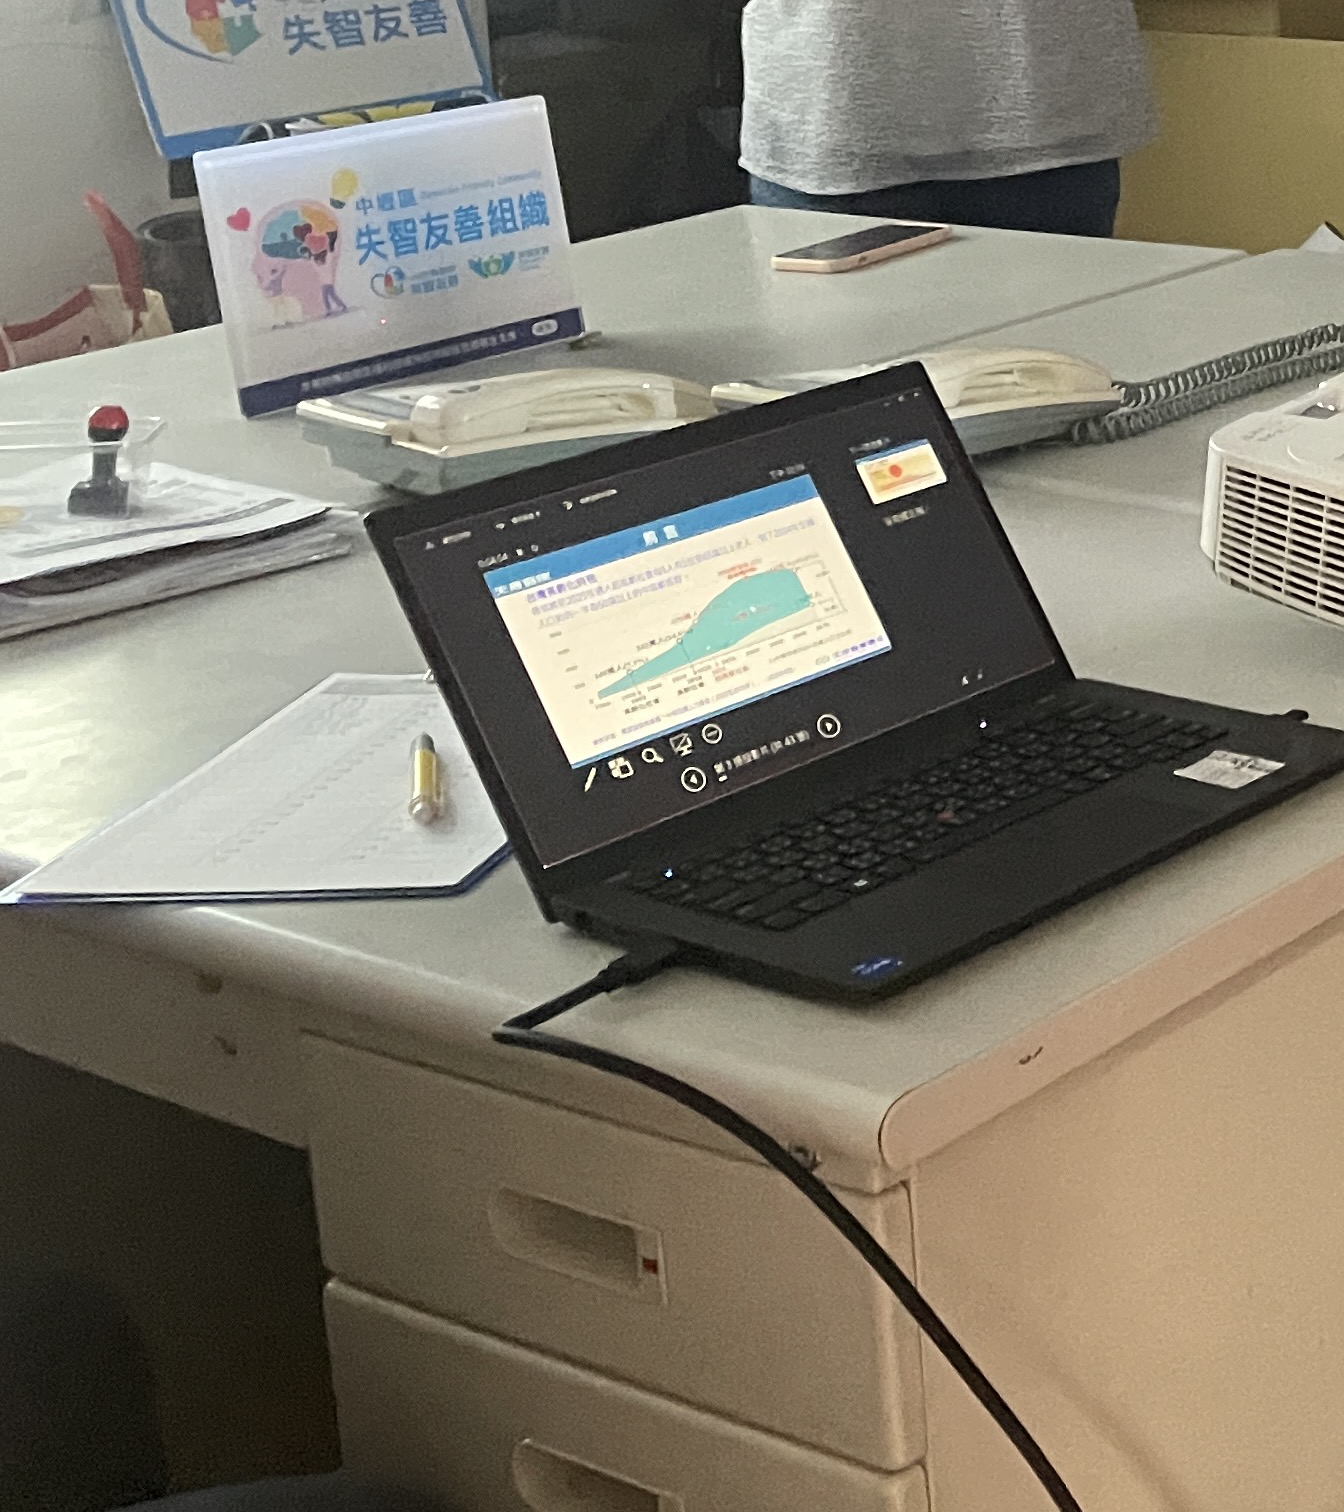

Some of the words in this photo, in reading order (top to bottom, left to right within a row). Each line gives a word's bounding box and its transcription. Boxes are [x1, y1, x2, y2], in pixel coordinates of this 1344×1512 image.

[355, 190, 550, 266] 失智友善組織
